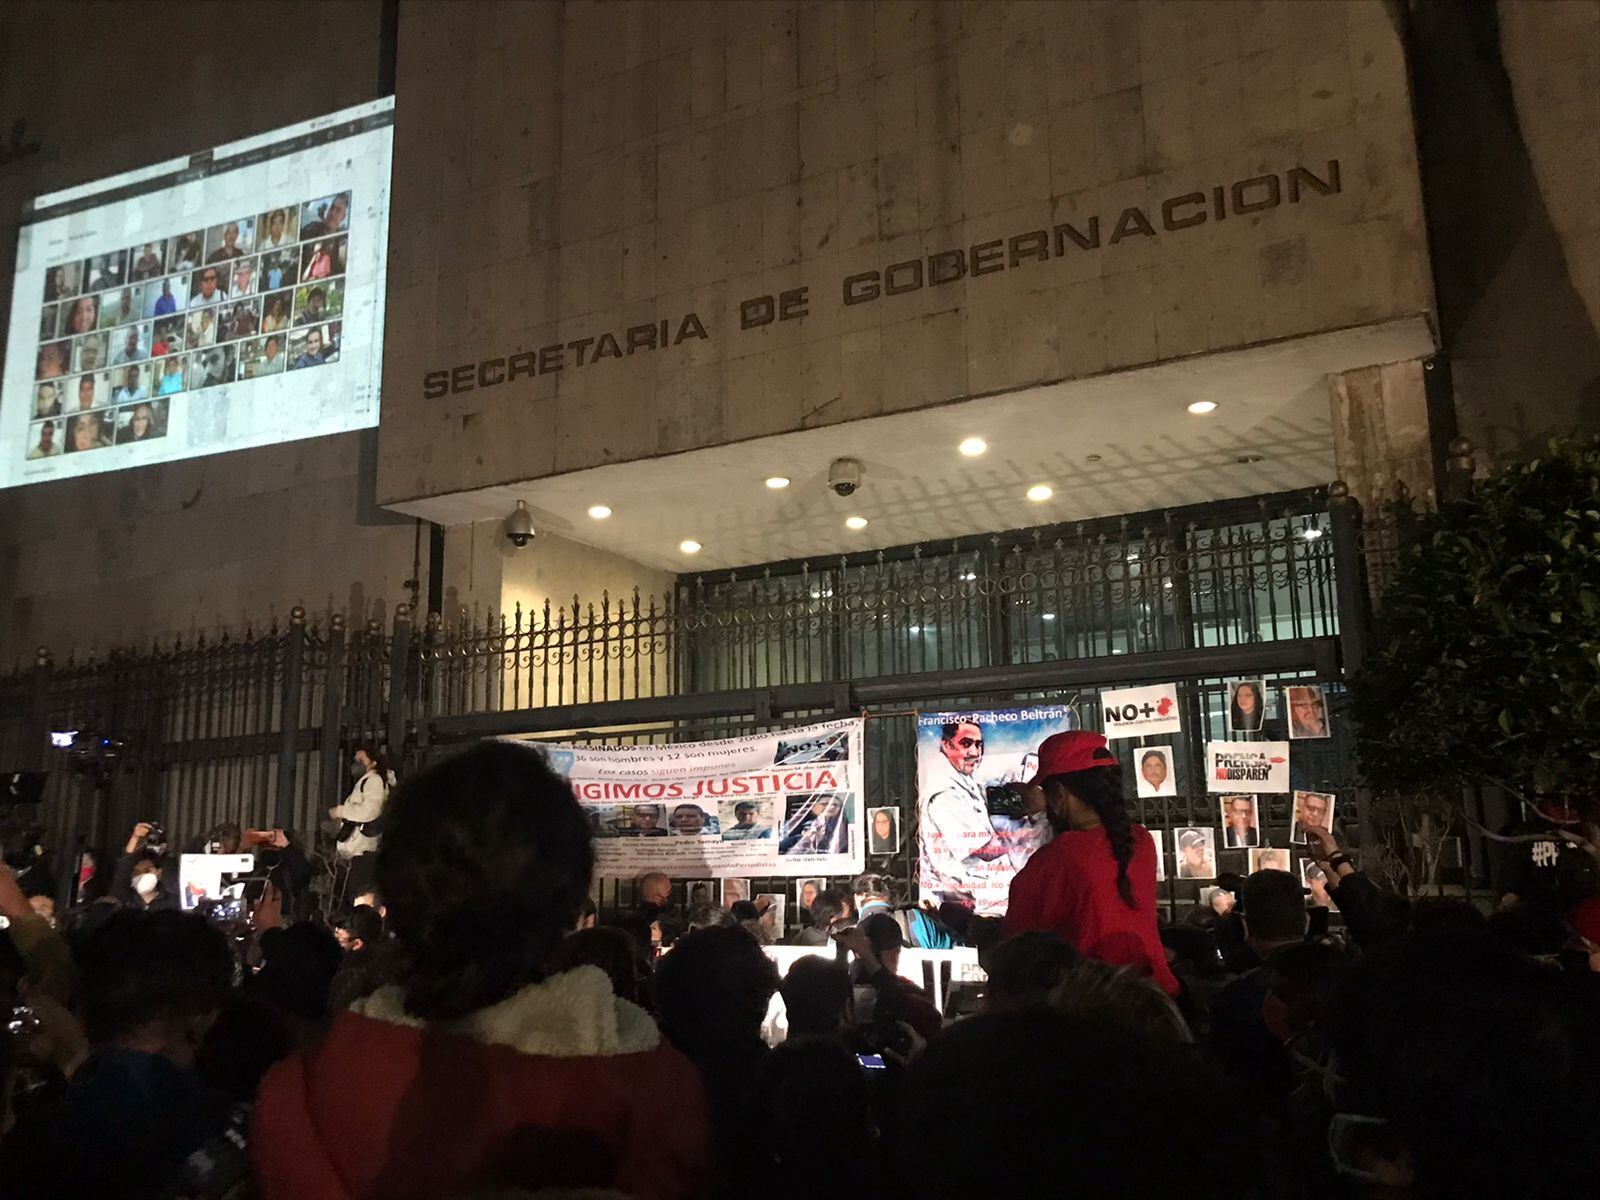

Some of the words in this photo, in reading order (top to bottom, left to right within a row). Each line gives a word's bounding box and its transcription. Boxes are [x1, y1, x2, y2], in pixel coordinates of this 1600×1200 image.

[422, 313, 709, 399] SECRETARIA
[739, 286, 810, 330] DE
[842, 159, 1342, 306] GOBERNACION
[919, 714, 967, 726] Francisco
[972, 712, 1018, 724] Pacheco
[1021, 708, 1063, 720] Beltrán
[698, 738, 735, 748] desde
[738, 733, 769, 744] 2000
[608, 755, 656, 764] hombres
[667, 753, 681, 761] 12
[619, 768, 649, 776] casos
[574, 782, 684, 800] IGIMOS
[692, 769, 838, 797] JUSTICIA
